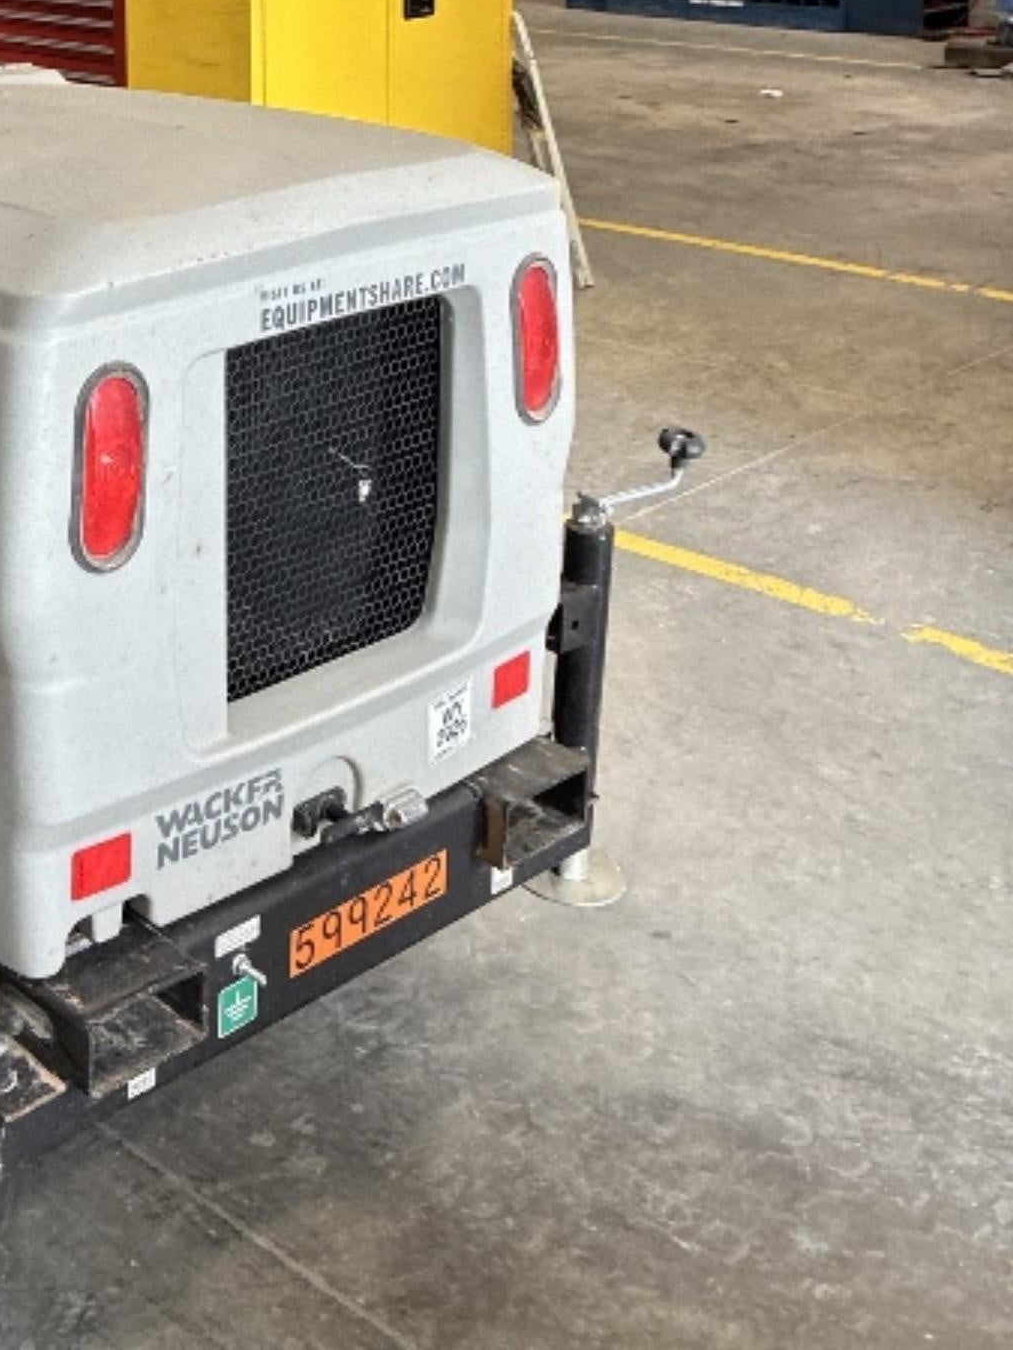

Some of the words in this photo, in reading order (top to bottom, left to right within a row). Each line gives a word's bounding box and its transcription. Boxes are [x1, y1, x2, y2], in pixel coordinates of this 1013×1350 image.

[261, 263, 465, 331] EQUIPMENTSHARE.COM
[155, 768, 284, 838] WACKER
[156, 793, 285, 870] NEUSON
[295, 856, 442, 970] 599242
